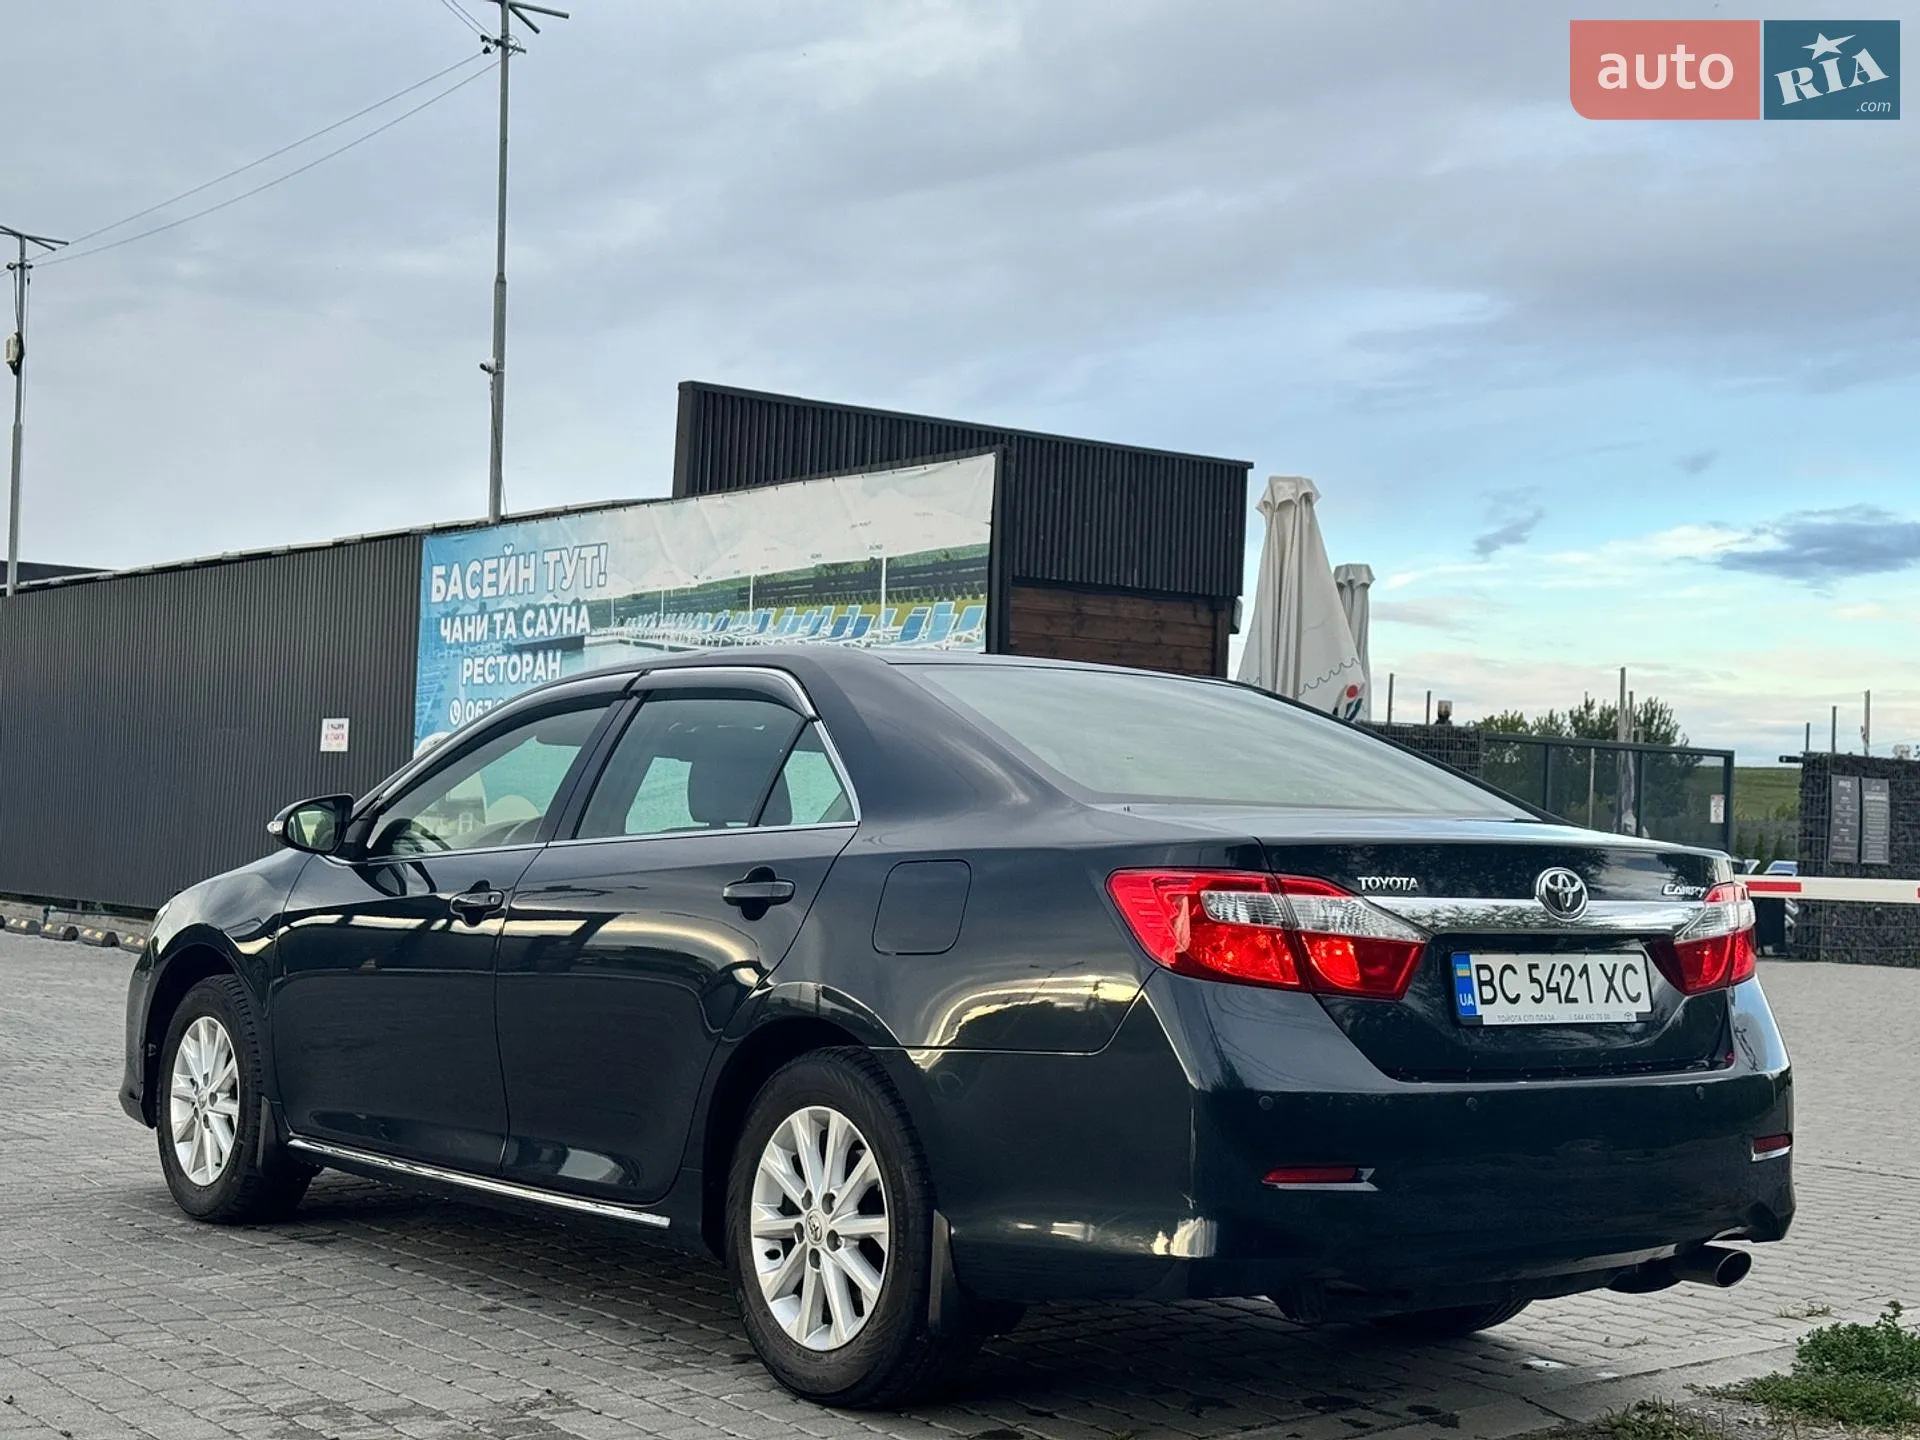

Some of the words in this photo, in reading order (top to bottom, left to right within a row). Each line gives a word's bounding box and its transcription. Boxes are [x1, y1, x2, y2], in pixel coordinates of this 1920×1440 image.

[430, 543, 536, 603] БАСЕЙН
[543, 543, 609, 592] ТУТ!
[440, 611, 488, 644] ЧАНИ
[493, 607, 517, 640] ТА
[522, 604, 591, 638] САУНА
[461, 650, 562, 685] РЕСТОРАН
[1356, 876, 1419, 891] TOYOTA
[1459, 993, 1475, 1007] UA
[1475, 963, 1521, 1006] BC
[1527, 963, 1594, 1005] 5421
[1599, 963, 1642, 1004] XC
